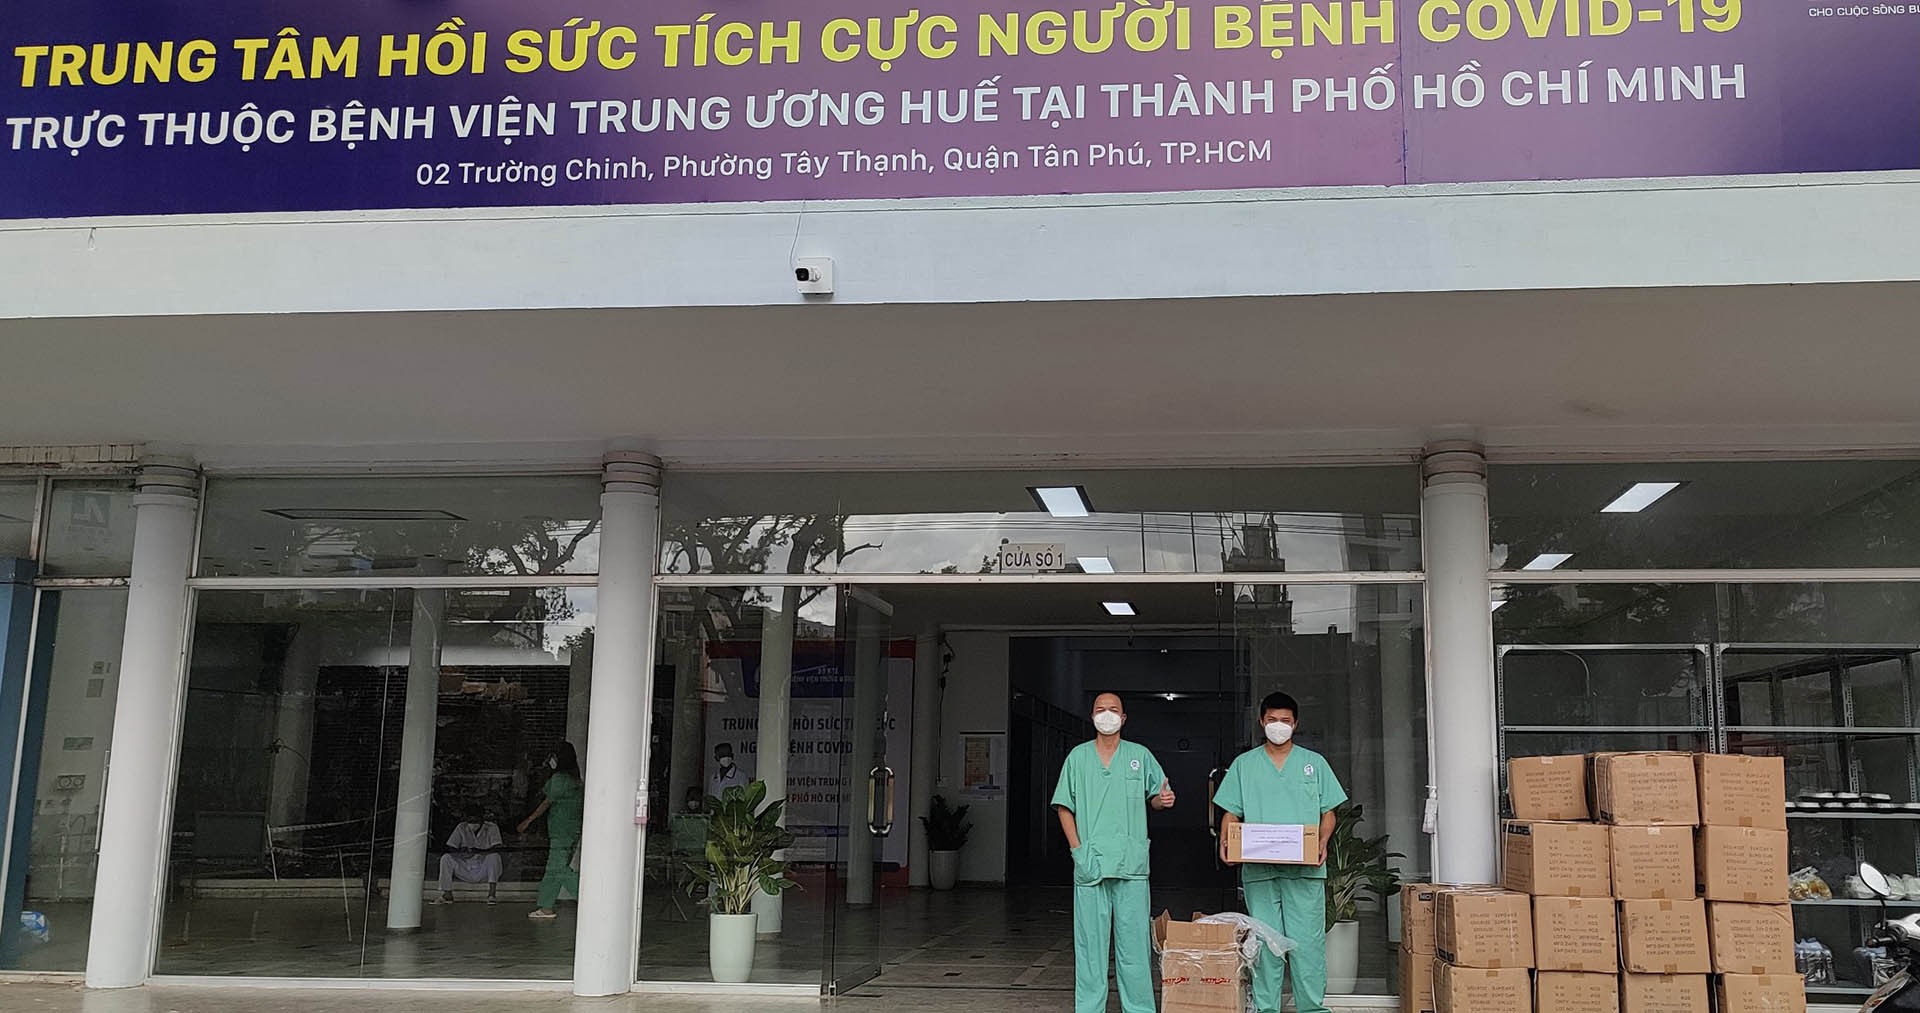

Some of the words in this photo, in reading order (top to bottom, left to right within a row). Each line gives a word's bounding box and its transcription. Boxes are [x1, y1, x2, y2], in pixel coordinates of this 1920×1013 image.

[1809, 8, 1833, 17] CHO
[1837, 5, 1869, 17] CUỘC
[14, 39, 216, 87] TRUNG
[233, 26, 359, 80] TÂM
[378, 17, 487, 77] HỒI
[504, 17, 637, 73] SỨC
[655, 13, 800, 67] TÍCH
[821, 9, 958, 72] CỰC
[978, 0, 1190, 57] NGƯỜI
[1214, 0, 1395, 60] BỆNH
[1418, 0, 1742, 42] COVID-19
[6, 110, 126, 157] TRỰC
[138, 102, 295, 152] THUỘC
[309, 100, 435, 150] BỆNH
[449, 95, 556, 146] VIỆN
[570, 96, 731, 135] TRUNG
[746, 89, 885, 129] ƯƠNG
[901, 75, 1002, 124] HUẾ
[1013, 85, 1085, 129] TẠI
[1100, 74, 1274, 118] THÀNH
[1292, 63, 1395, 113] PHỐ
[1413, 60, 1486, 109] HỒ
[1501, 60, 1593, 106] CHÍ
[1607, 63, 1746, 103] MINH
[416, 163, 450, 186] 02
[458, 160, 557, 188] Trường
[565, 157, 655, 182] Chinh,
[664, 154, 772, 180] Phường
[780, 150, 829, 178] Tây
[837, 149, 934, 177] Thạnh,
[943, 145, 1019, 174] Quận
[1027, 145, 1079, 168] Tân
[1089, 141, 1152, 168] Phú,
[1160, 139, 1272, 165] TP.HCM
[1035, 544, 1054, 567] SỐ
[1057, 552, 1063, 566] 1
[790, 739, 814, 757] ỆNH
